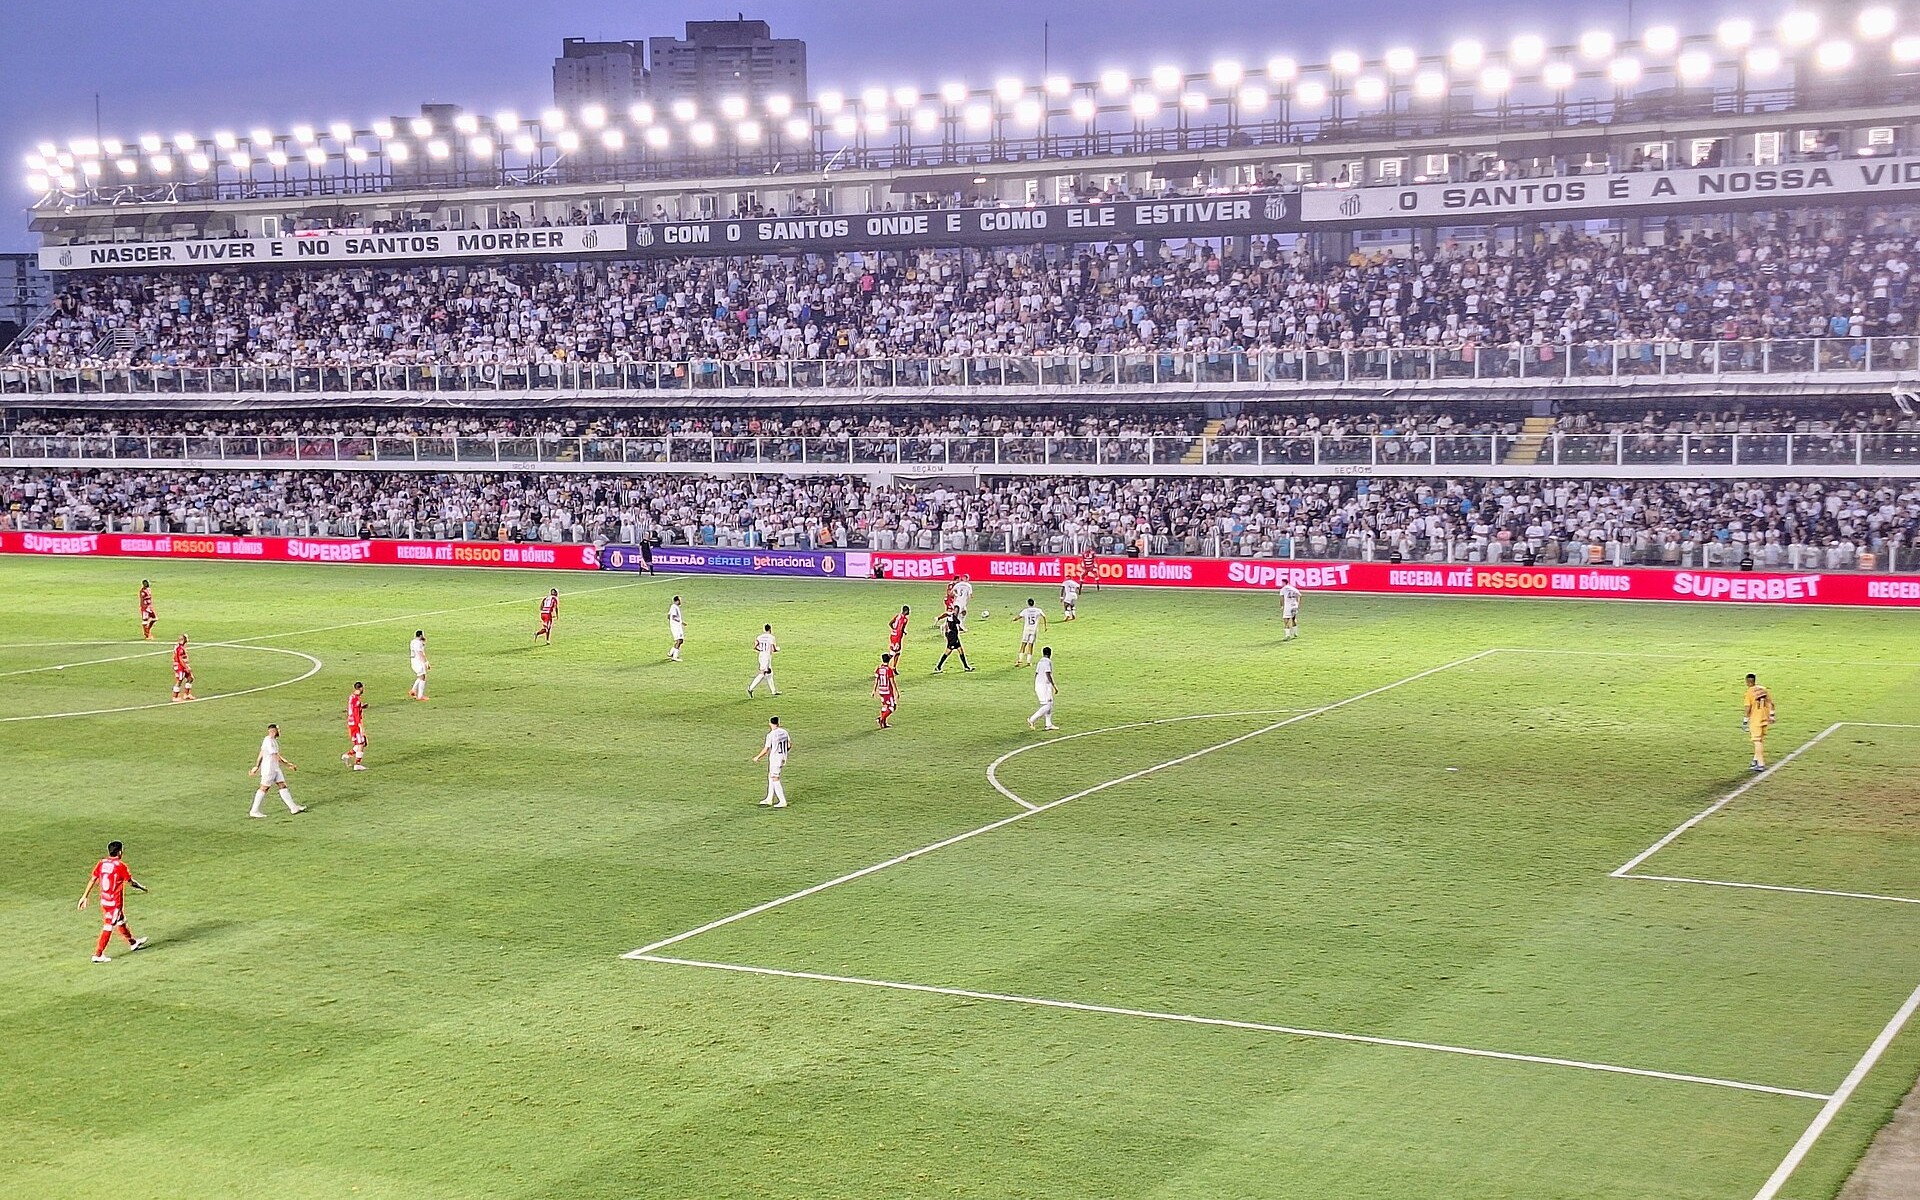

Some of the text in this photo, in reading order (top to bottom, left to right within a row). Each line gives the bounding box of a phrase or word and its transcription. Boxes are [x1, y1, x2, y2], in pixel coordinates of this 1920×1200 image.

[1399, 191, 1417, 210] O
[1442, 182, 1585, 208] SANTOS
[1608, 175, 1629, 199] É
[1651, 177, 1677, 197] A
[1698, 168, 1833, 194] NOSSA
[664, 200, 1251, 243] COM O SANTOS ONDE E COMO ELE ESTIVER
[90, 231, 563, 263] NASCER, VIVER E NO SANTOS MORRER
[23, 534, 98, 553] SUPERBET
[121, 537, 263, 555] RECEBA ATÉ R$500 EM BÔNUS
[287, 540, 371, 561] SUPERBET
[397, 544, 555, 563] RECEBA ATÉ R$500 EM BÔNUS
[629, 553, 815, 570] BRSILEIRÃO SÉRIE B betnacional
[990, 560, 1036, 576] RECEBA
[1038, 558, 1061, 577] ATÉ
[1126, 562, 1145, 579] EM
[1149, 559, 1192, 580] BÔNUS
[1227, 562, 1350, 587] SUPERBET
[1390, 568, 1630, 591] RECEBA ATÉ R$500 EM BÔNUS
[1672, 572, 1821, 600] SUPERBET
